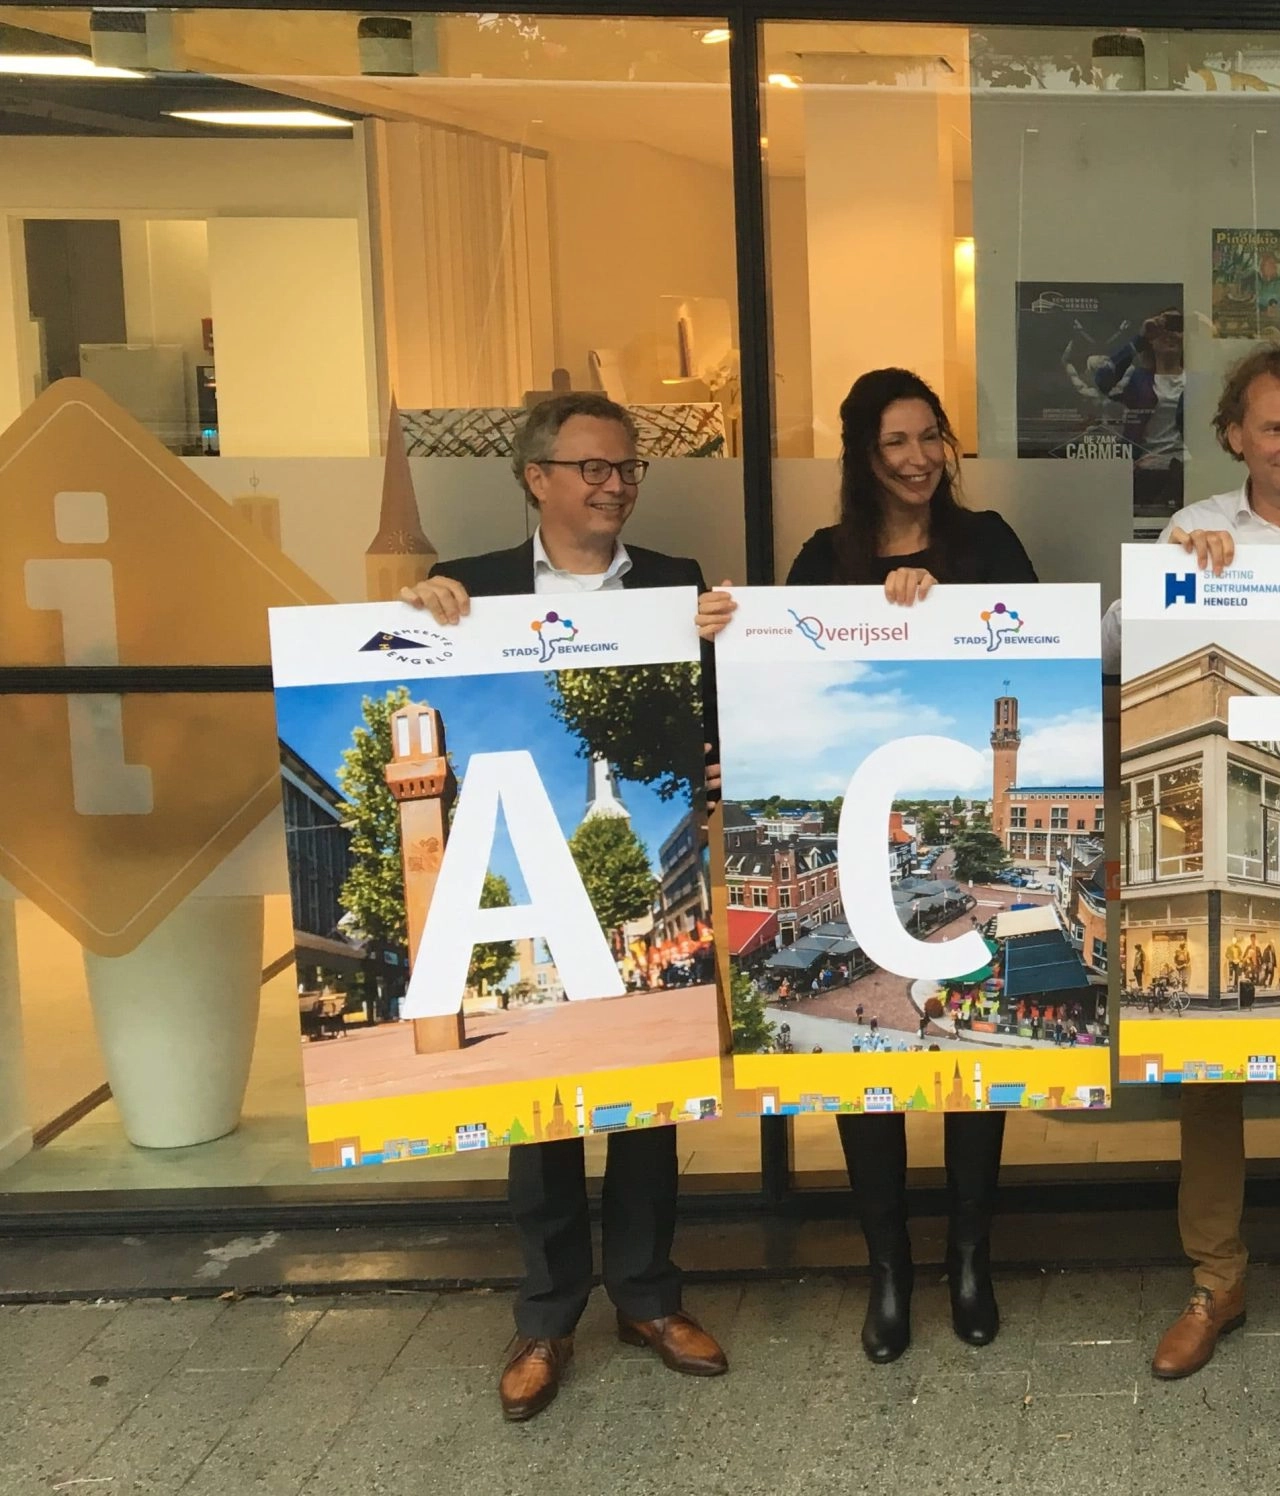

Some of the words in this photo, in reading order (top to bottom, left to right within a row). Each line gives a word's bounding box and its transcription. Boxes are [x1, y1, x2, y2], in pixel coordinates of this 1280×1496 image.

[1216, 232, 1278, 245] Pinokkio
[1083, 435, 1092, 444] DE
[1096, 435, 1118, 444] ZAAK
[1066, 443, 1133, 460] CARMEN
[1203, 596, 1248, 607] HENGELO
[745, 626, 793, 637] provincie
[953, 635, 987, 645] STADS
[1004, 635, 1060, 645] BEWEGING
[502, 647, 539, 657] STADS
[557, 643, 619, 654] BEWEGING
[838, 735, 993, 980] C
[402, 750, 628, 1019] A
